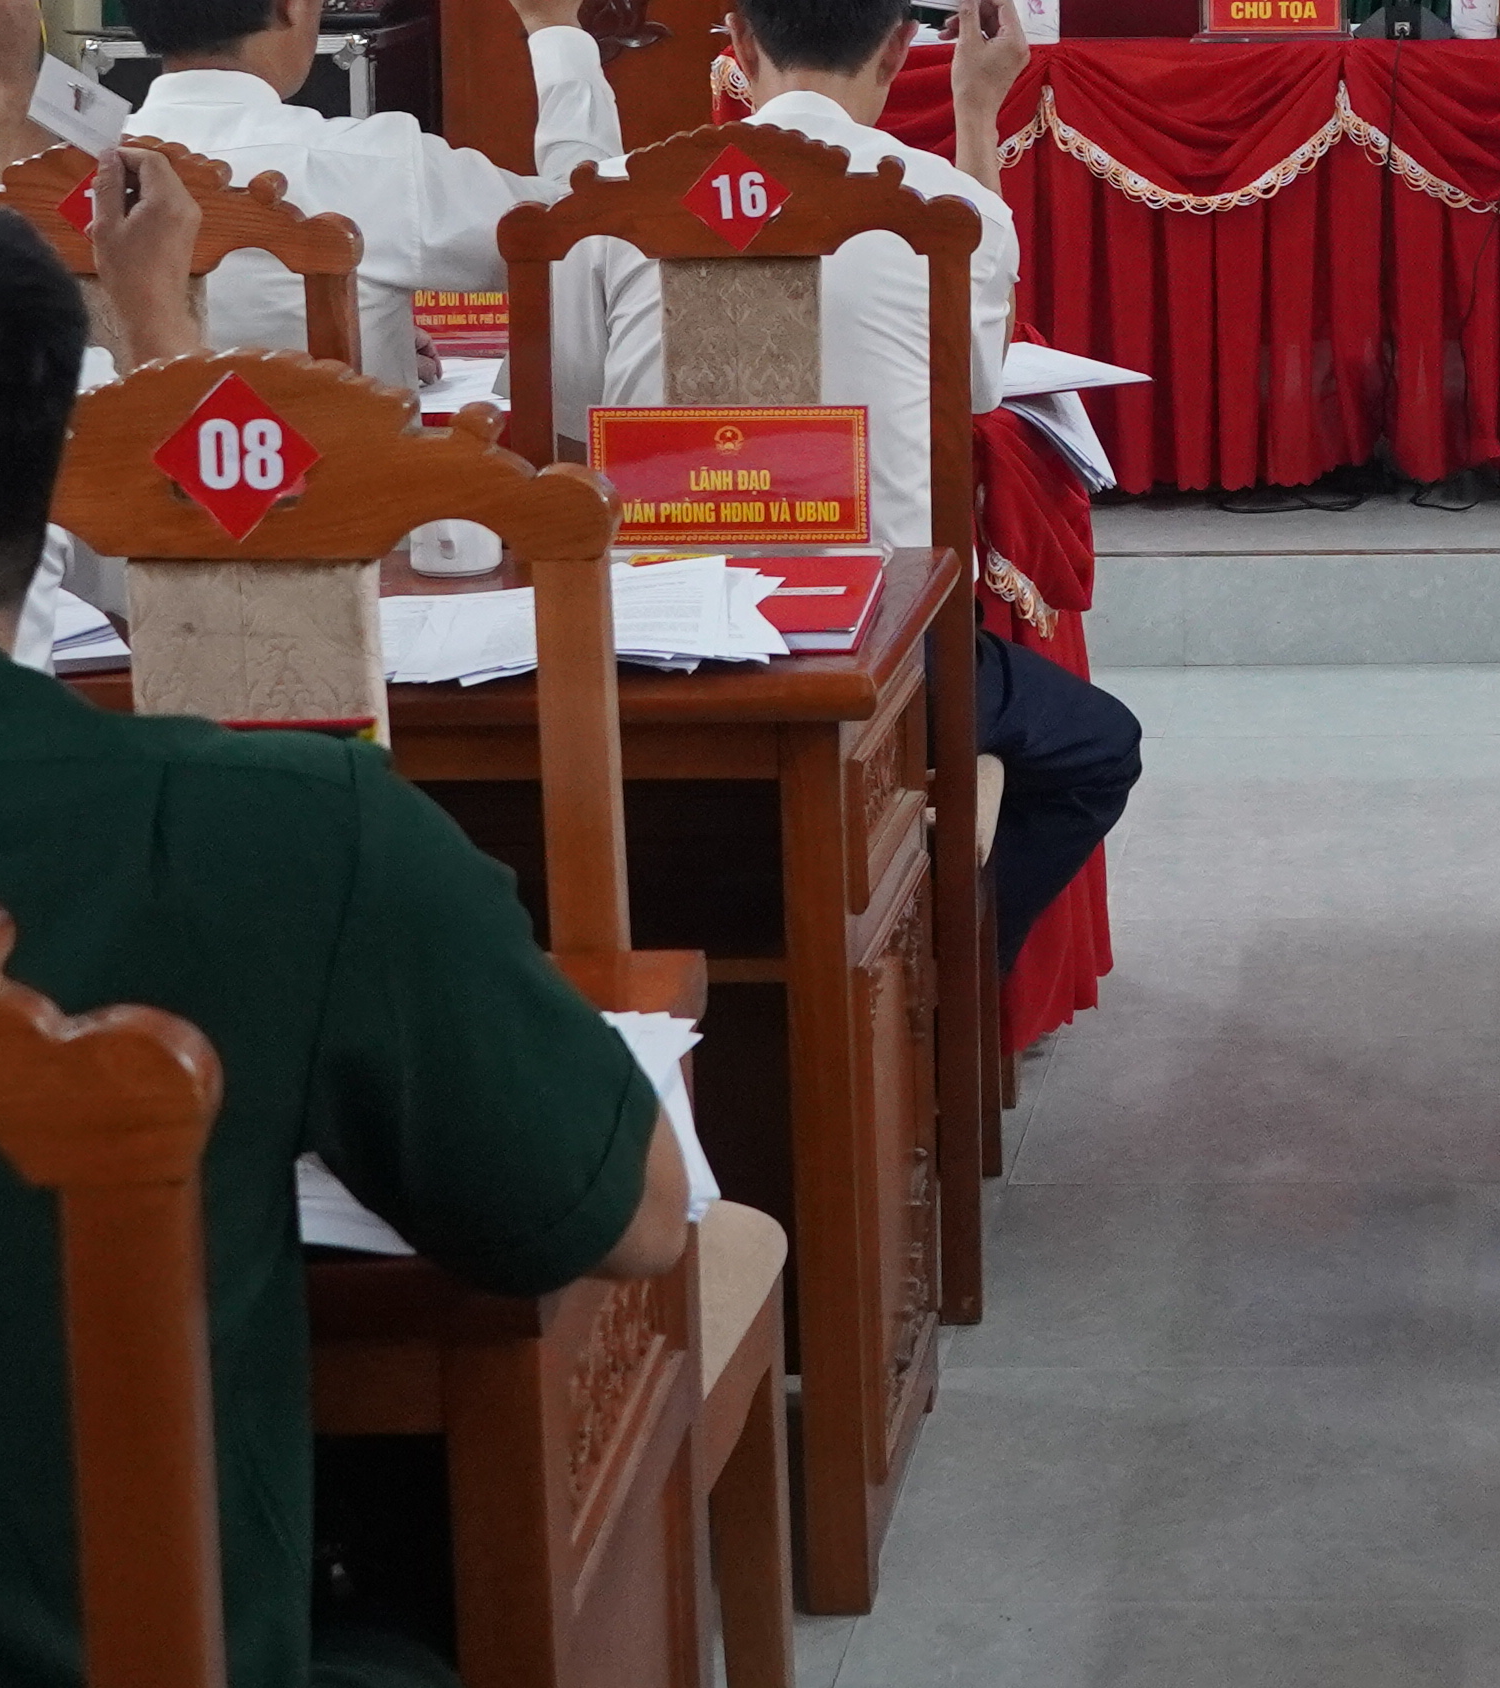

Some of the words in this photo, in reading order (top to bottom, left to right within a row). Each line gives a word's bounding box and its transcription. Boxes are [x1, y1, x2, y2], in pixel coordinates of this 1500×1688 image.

[1278, 0, 1318, 23] TỌA
[711, 170, 768, 221] 16
[198, 417, 285, 492] 08
[690, 466, 734, 492] LÃNH
[737, 469, 771, 495] ĐẠO
[622, 498, 655, 524] VĂN
[660, 496, 716, 524] PHÒNG
[721, 501, 765, 524] HĐND
[770, 497, 791, 523] VÀ
[796, 501, 840, 523] UBND
